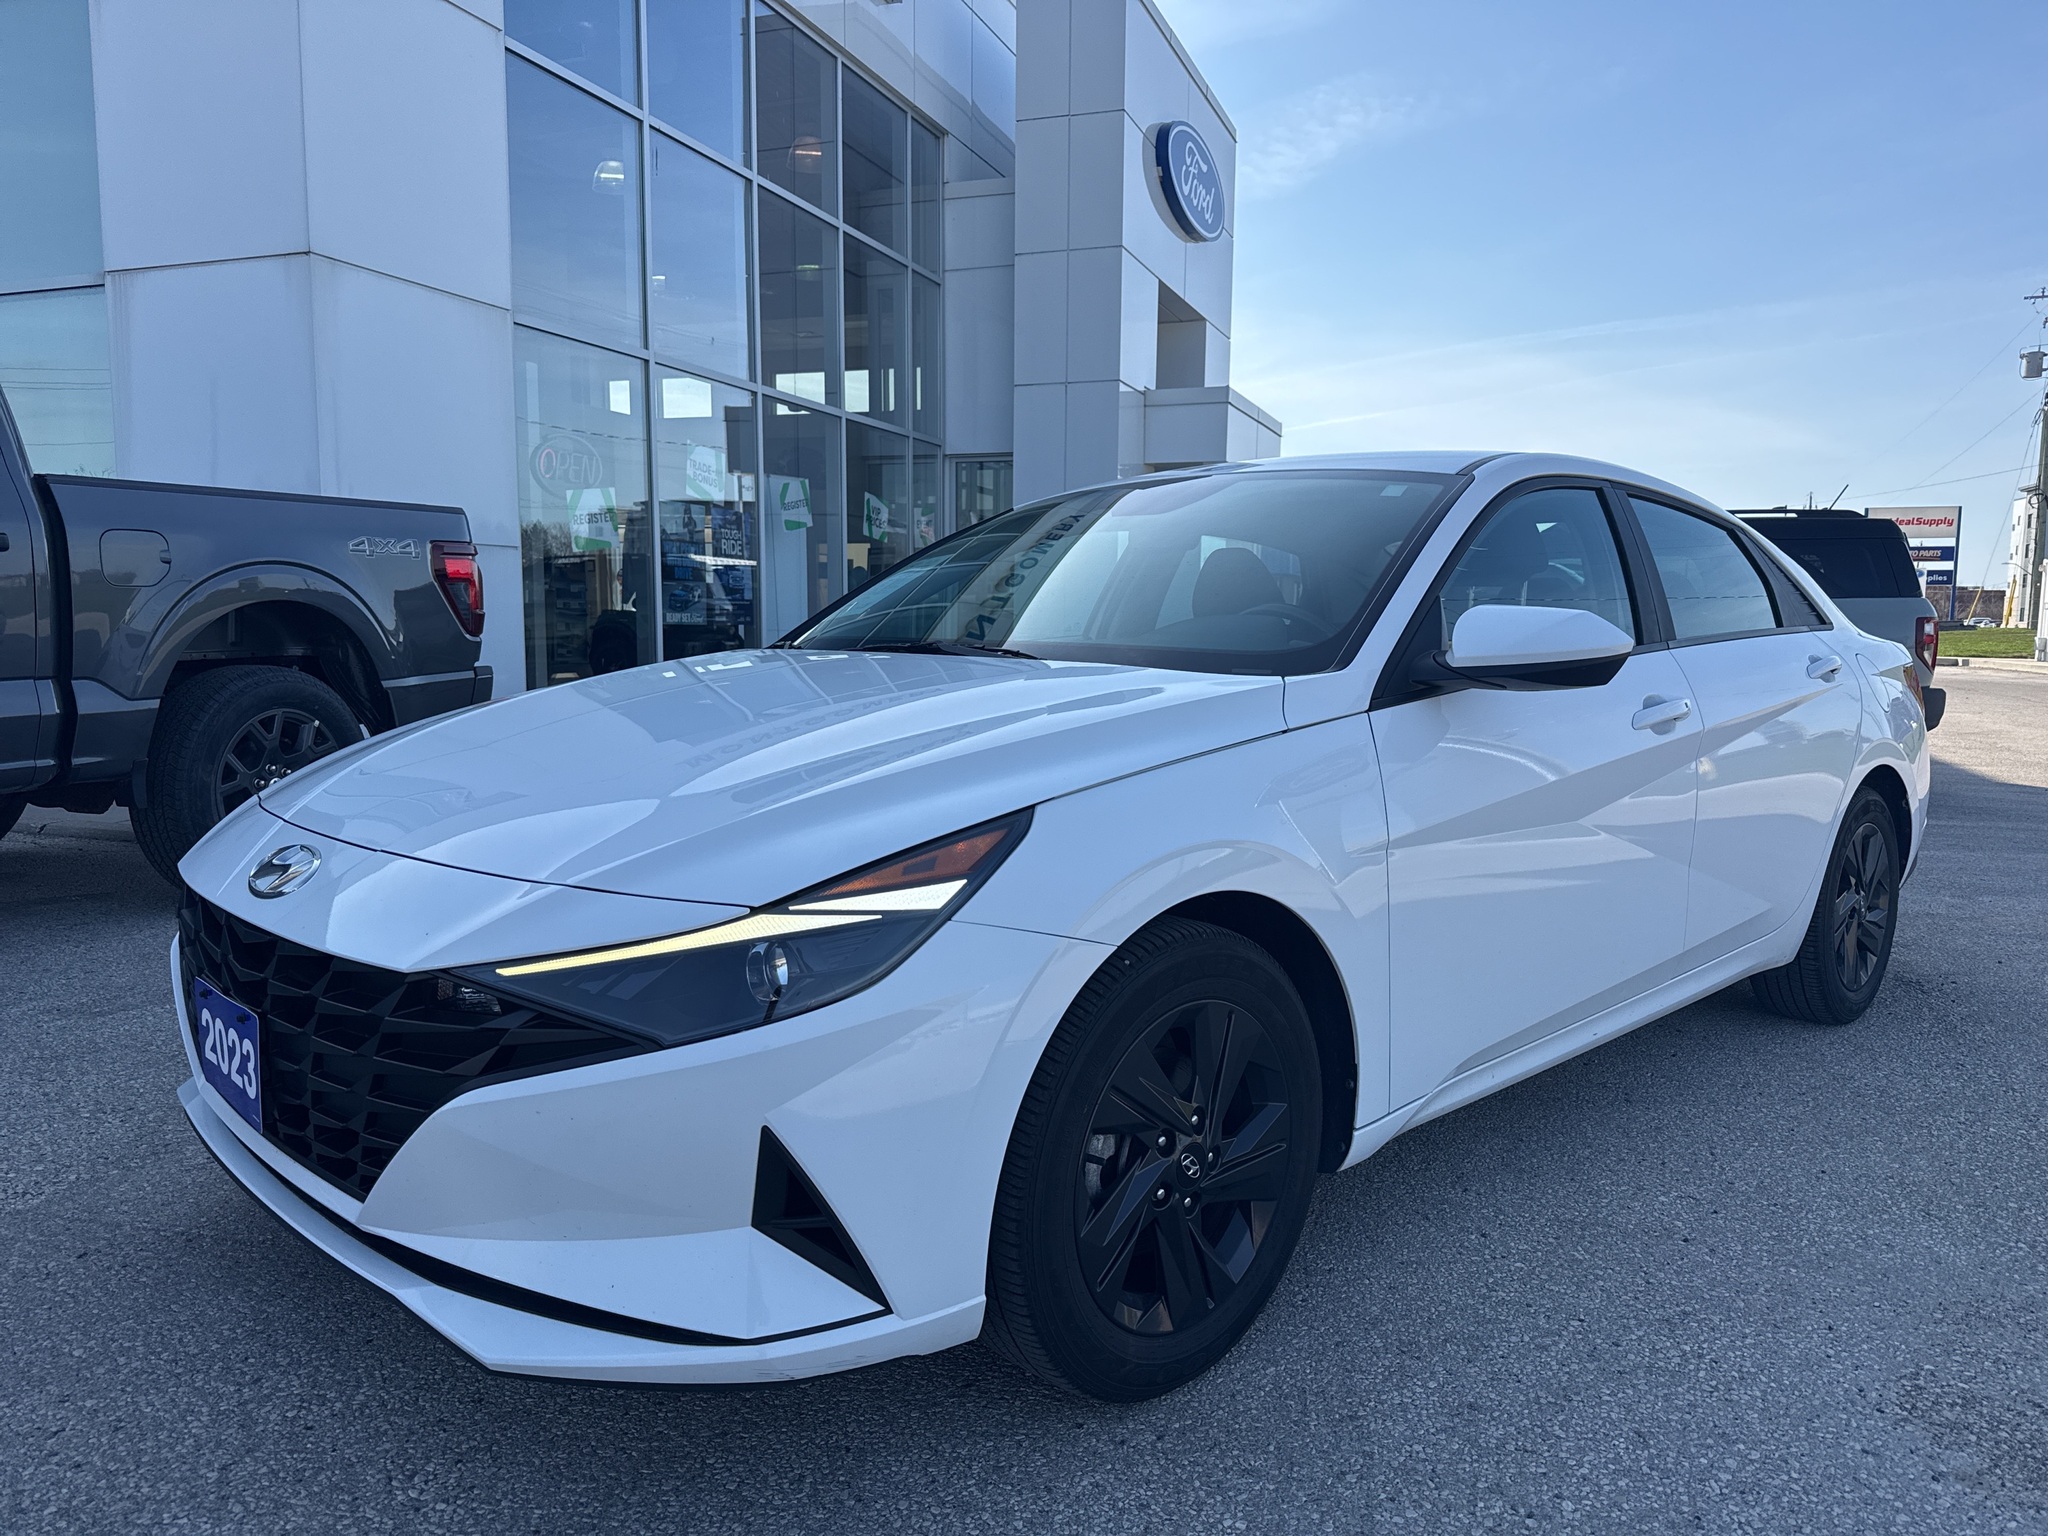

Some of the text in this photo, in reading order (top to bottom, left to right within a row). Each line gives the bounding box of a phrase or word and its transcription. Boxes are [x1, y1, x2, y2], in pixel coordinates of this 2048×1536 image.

[1181, 141, 1214, 225] Ford
[540, 448, 597, 485] OPEN
[692, 471, 719, 489] BONUS
[871, 504, 881, 516] VIP
[573, 511, 615, 526] REGISTER
[1894, 517, 1954, 527] ealSupply
[721, 528, 742, 540] TOUGH
[721, 539, 743, 556] RIDE
[1926, 574, 1947, 583] plies
[201, 1007, 257, 1100] 2023
